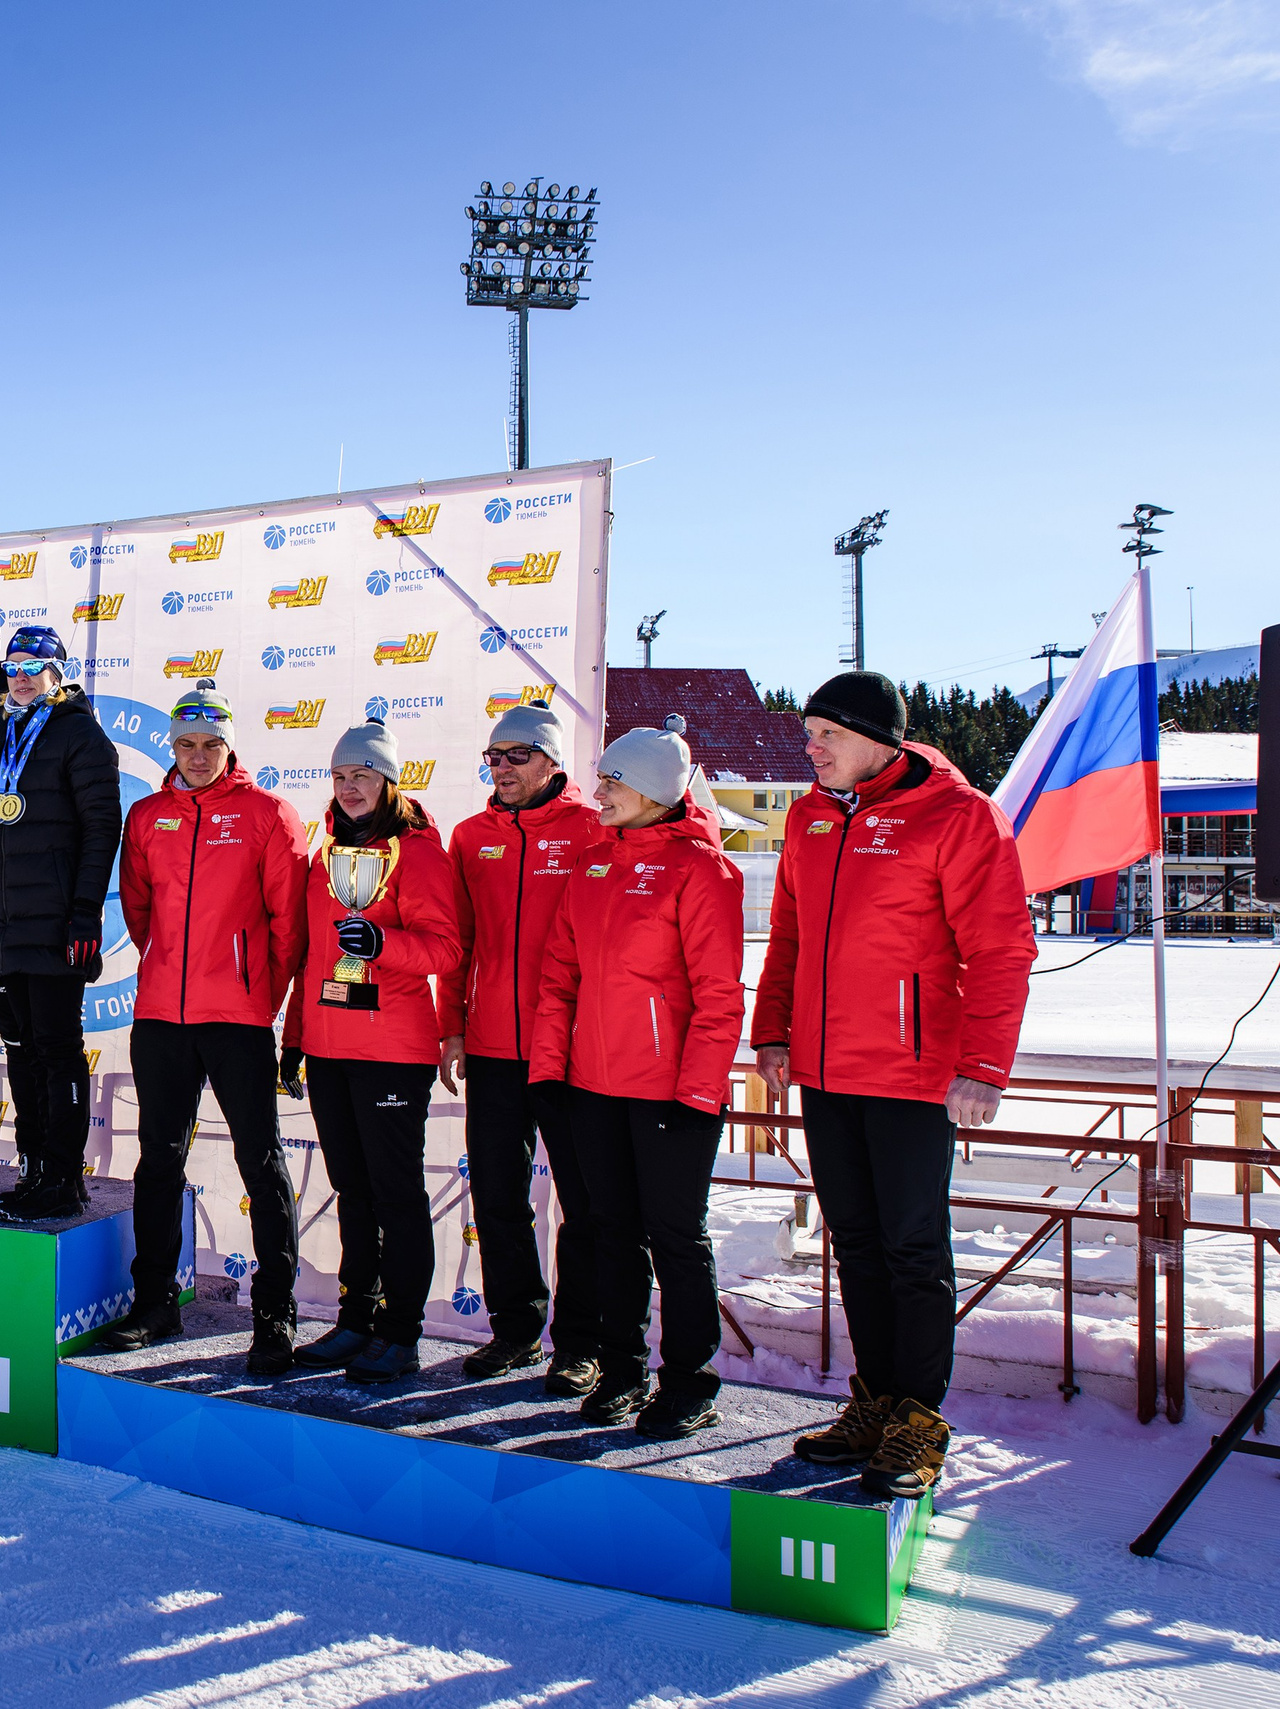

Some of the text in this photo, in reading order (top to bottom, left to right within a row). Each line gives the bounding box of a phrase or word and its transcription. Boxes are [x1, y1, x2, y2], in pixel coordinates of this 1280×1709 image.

[516, 493, 572, 509] РОССЕТИ
[404, 503, 440, 529] ВЭП
[516, 511, 547, 520] ТЮМЕНЬ
[289, 522, 335, 536] РОССЕТИ
[196, 531, 224, 554] ВЭП
[290, 538, 316, 546] ТЮМЕНЬ
[90, 545, 134, 555] РОССЕТИ
[10, 552, 38, 574] ВЭП
[520, 551, 561, 577] ВЭП
[395, 567, 444, 582] РОССЕТИ
[297, 576, 328, 601] ВЭП
[395, 584, 423, 592] ТЮМЕНЬ
[94, 593, 125, 614] ВЭП
[188, 591, 232, 602] РОССЕТИ
[9, 608, 47, 618] РОССЕТИ
[511, 626, 568, 639] РОССЕТИ
[403, 631, 438, 656] ВЭП
[511, 642, 542, 650] ТЮМЕНЬ
[289, 646, 335, 658] РОССЕТИ
[85, 658, 130, 668] РОССЕТИ
[191, 649, 224, 671] ВЭП
[392, 696, 443, 709] РОССЕТИ
[294, 699, 326, 722] ВЭП
[112, 711, 142, 734] АО
[284, 769, 331, 779] РОССЕТИ
[401, 760, 436, 784] ВЭП
[95, 988, 138, 1019] ГОН
[979, 1062, 1006, 1074] MEMBRANE
[281, 1137, 315, 1150] ССЕТИ
